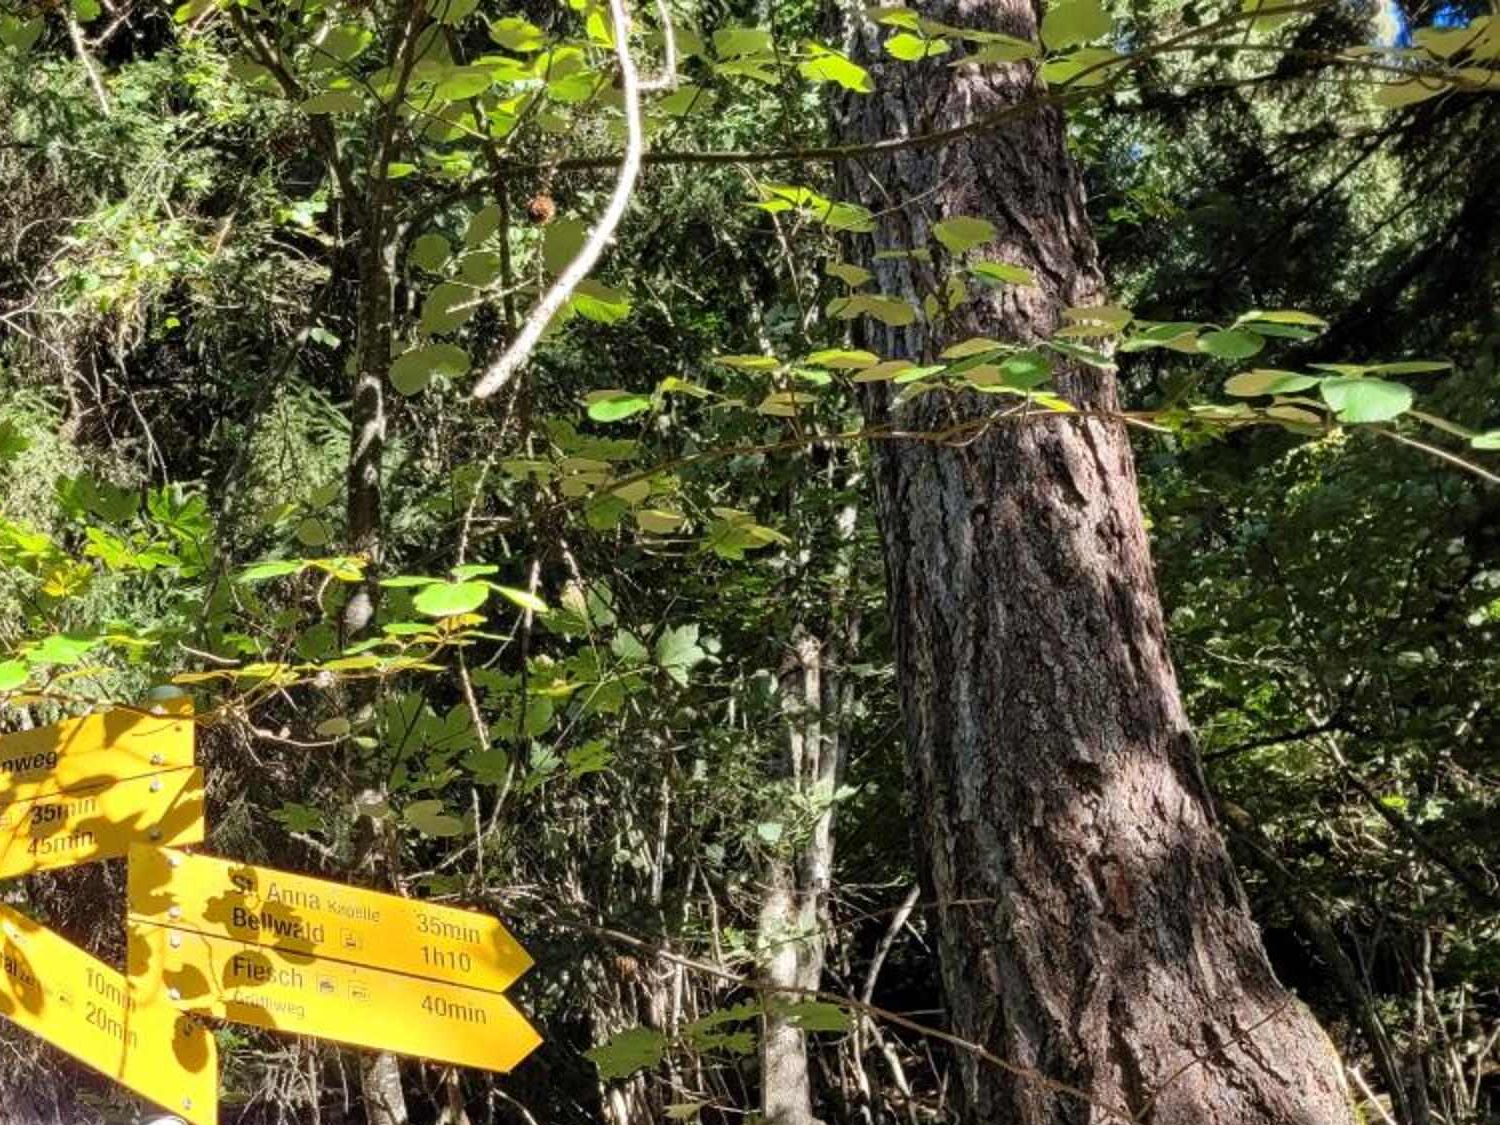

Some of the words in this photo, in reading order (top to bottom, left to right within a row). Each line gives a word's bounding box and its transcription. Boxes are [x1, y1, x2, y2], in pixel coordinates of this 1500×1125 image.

[31, 799, 97, 824] 35min
[27, 830, 94, 856] 45min
[267, 883, 321, 911] Anna
[233, 907, 325, 943] Bellwald
[416, 913, 481, 944] 35min
[233, 956, 303, 988] Fiesch
[421, 945, 471, 973] 1h10
[86, 967, 137, 1013] 10min
[421, 994, 487, 1024] 40min
[86, 1001, 138, 1048] 20min
